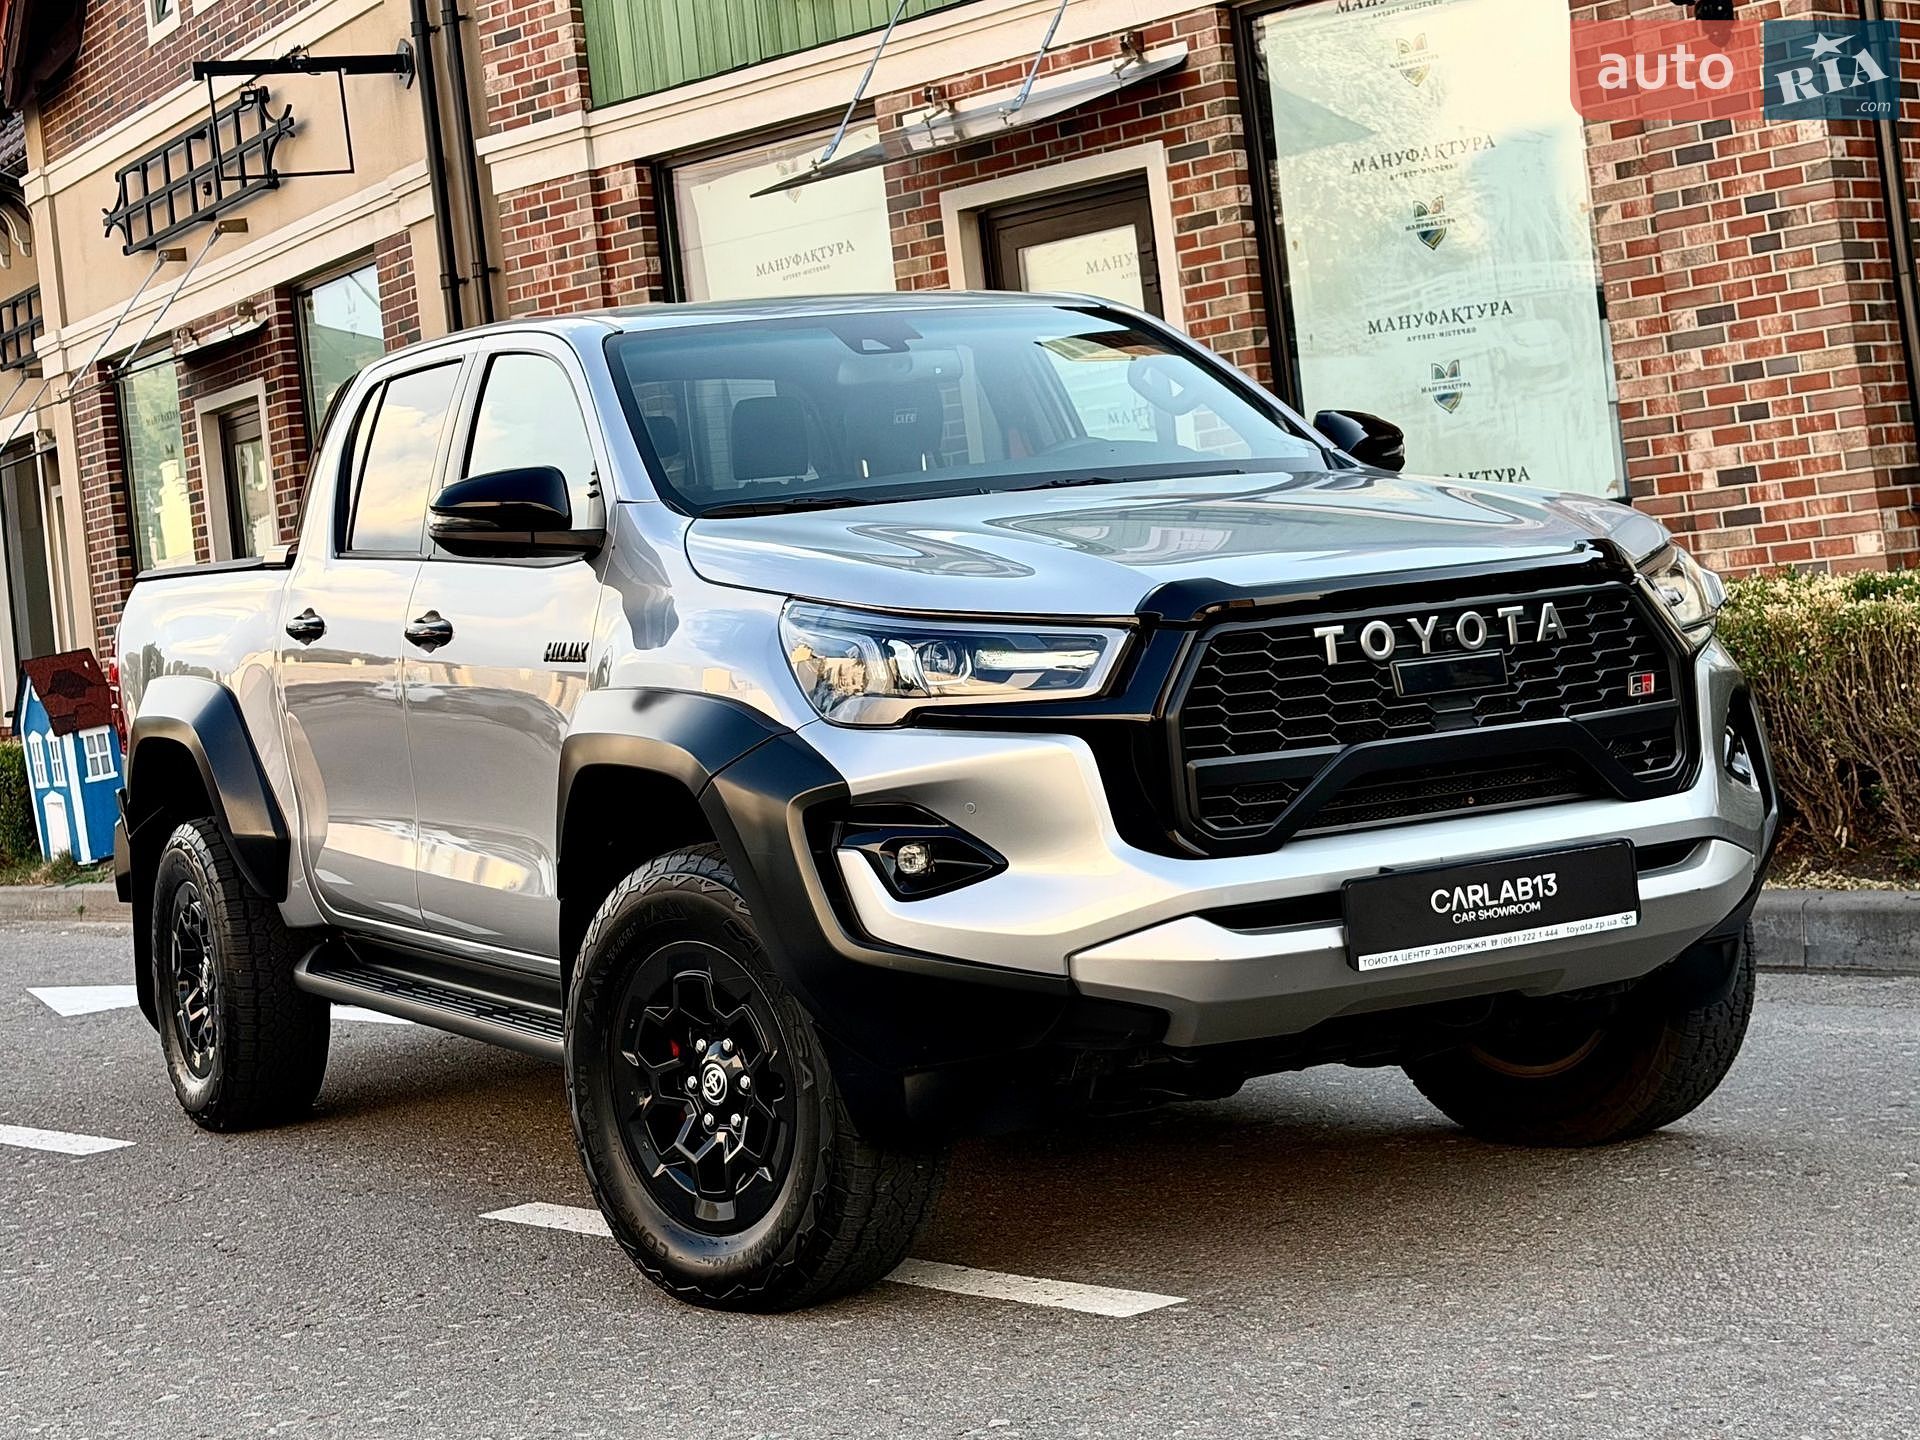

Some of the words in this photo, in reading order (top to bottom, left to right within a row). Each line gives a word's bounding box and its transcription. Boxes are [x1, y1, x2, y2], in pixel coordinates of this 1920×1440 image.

[1351, 134, 1497, 174] МАНУФАКТУРА
[755, 239, 855, 277] МАНУФАКТУРА
[1367, 299, 1513, 335] МАНУФАКТУРА
[543, 641, 590, 663] HILUX
[1313, 602, 1568, 666] TOYOTA
[1430, 872, 1558, 914] CARLAB13
[1452, 910, 1476, 924] CAR
[1478, 900, 1541, 920] SHOWROOM
[1401, 949, 1431, 962] ЦЕНТР
[1433, 941, 1487, 956] ЗАПОРІЖЖЯ
[1500, 935, 1520, 947] (061)
[1523, 931, 1536, 942] 222
[1544, 928, 1559, 937] 444
